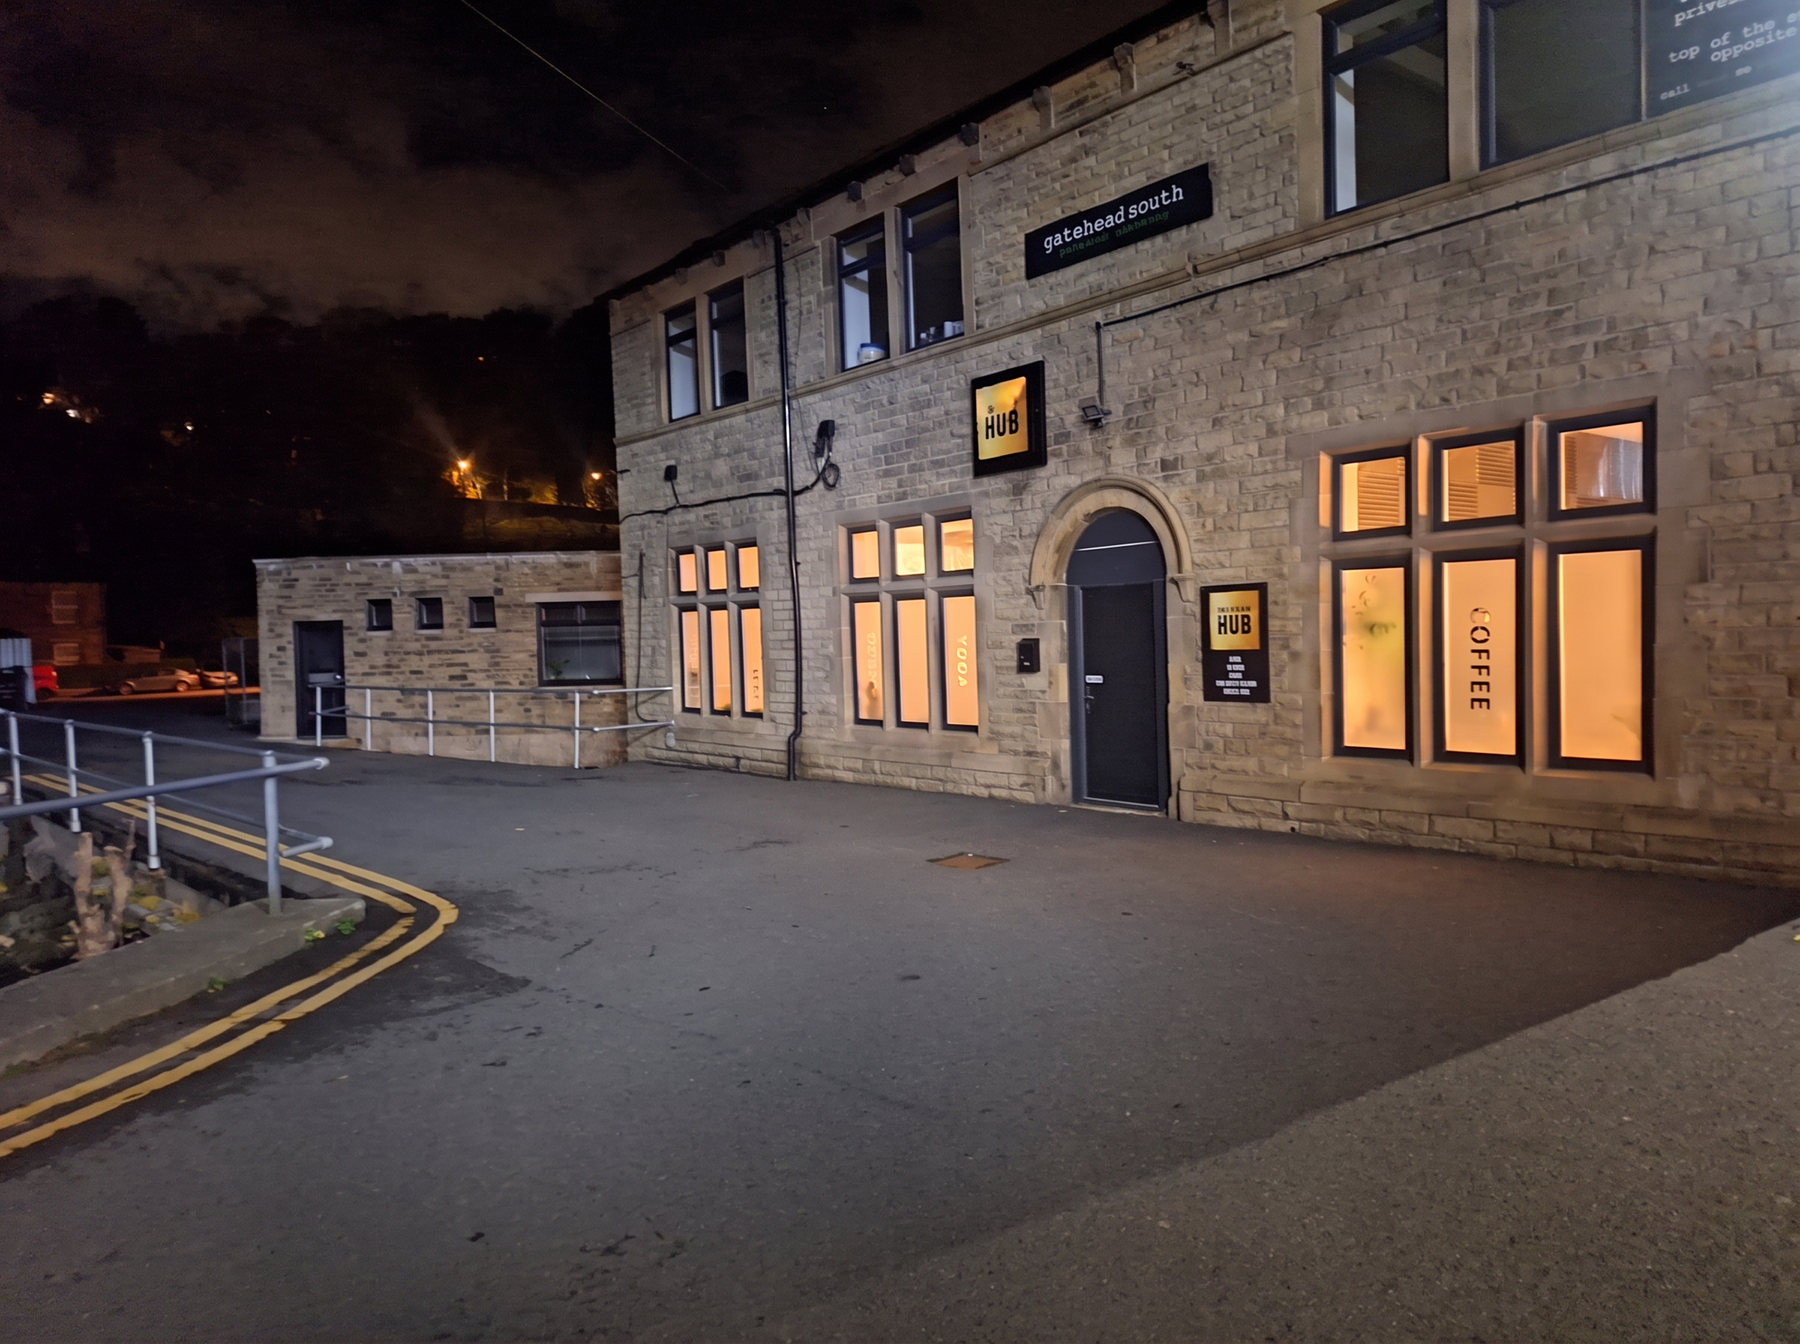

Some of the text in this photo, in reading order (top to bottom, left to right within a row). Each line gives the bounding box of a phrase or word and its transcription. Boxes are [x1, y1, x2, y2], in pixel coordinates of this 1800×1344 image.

[1668, 20, 1776, 62] top of the
[1710, 26, 1798, 62] opposite
[1043, 206, 1125, 254] gatehead
[1128, 184, 1184, 219] south
[985, 409, 1019, 440] HUB
[1217, 614, 1252, 635] HUB
